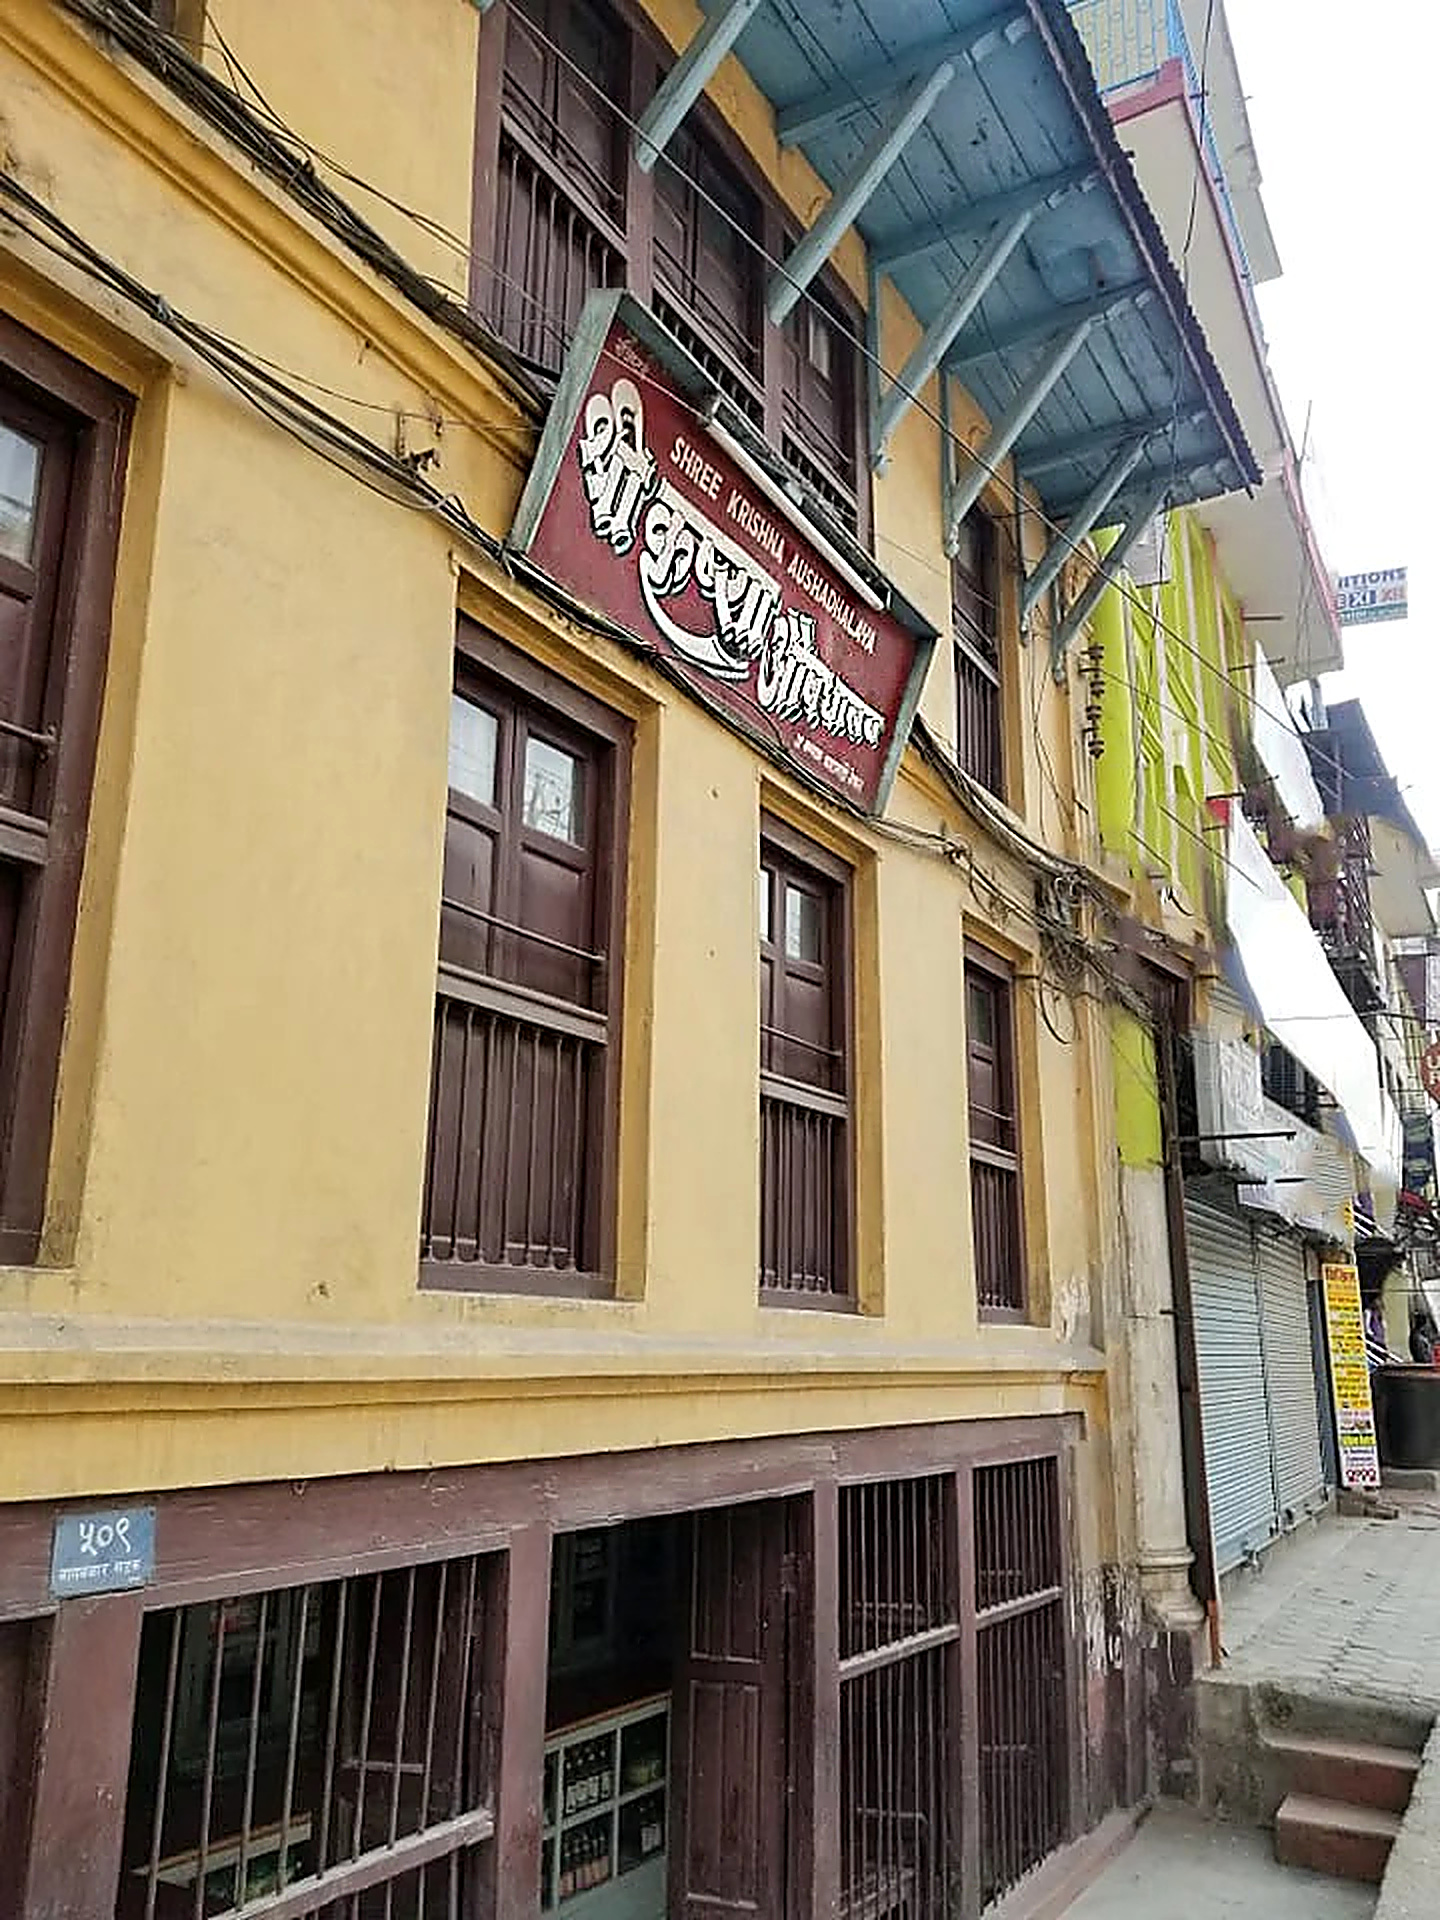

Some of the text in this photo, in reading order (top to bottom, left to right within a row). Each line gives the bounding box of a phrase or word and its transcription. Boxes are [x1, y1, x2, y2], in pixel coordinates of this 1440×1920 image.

[580, 378, 656, 555] श्री
[639, 478, 783, 681] कृष्ण
[670, 436, 877, 655] SHREE KRISHNA AUSHADHALAYA
